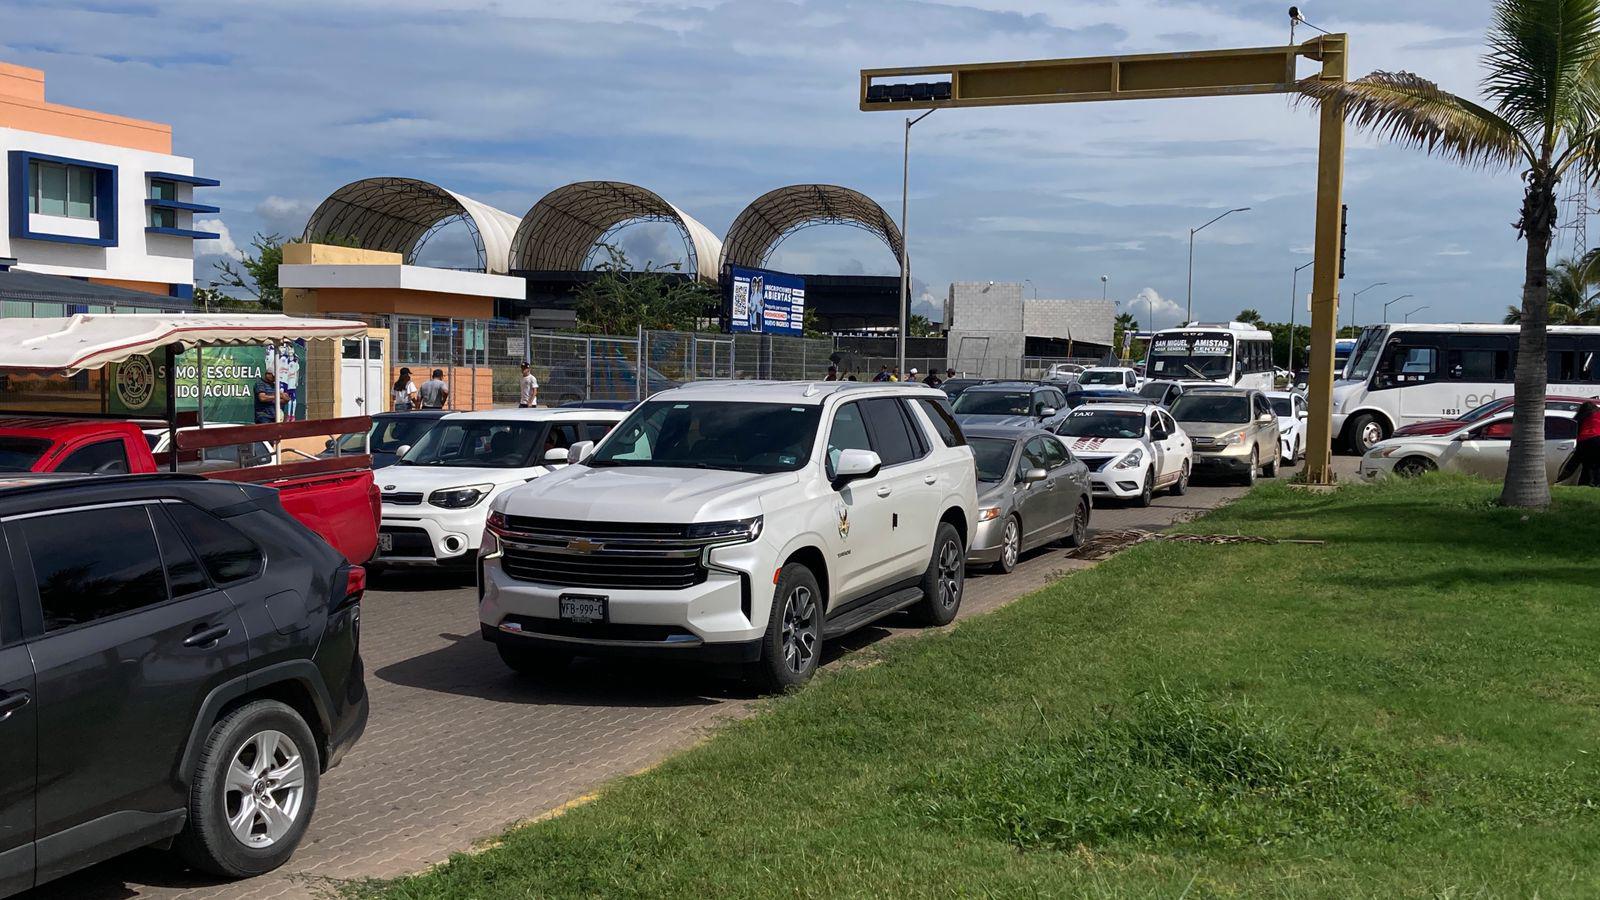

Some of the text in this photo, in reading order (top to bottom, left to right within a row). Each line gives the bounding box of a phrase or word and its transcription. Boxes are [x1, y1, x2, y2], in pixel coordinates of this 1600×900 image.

[764, 291, 792, 302] ABIERTAS
[1194, 339, 1229, 347] AMISTAD
[158, 365, 262, 379] SMO ESCUELA
[204, 381, 251, 398] ÁGUILA
